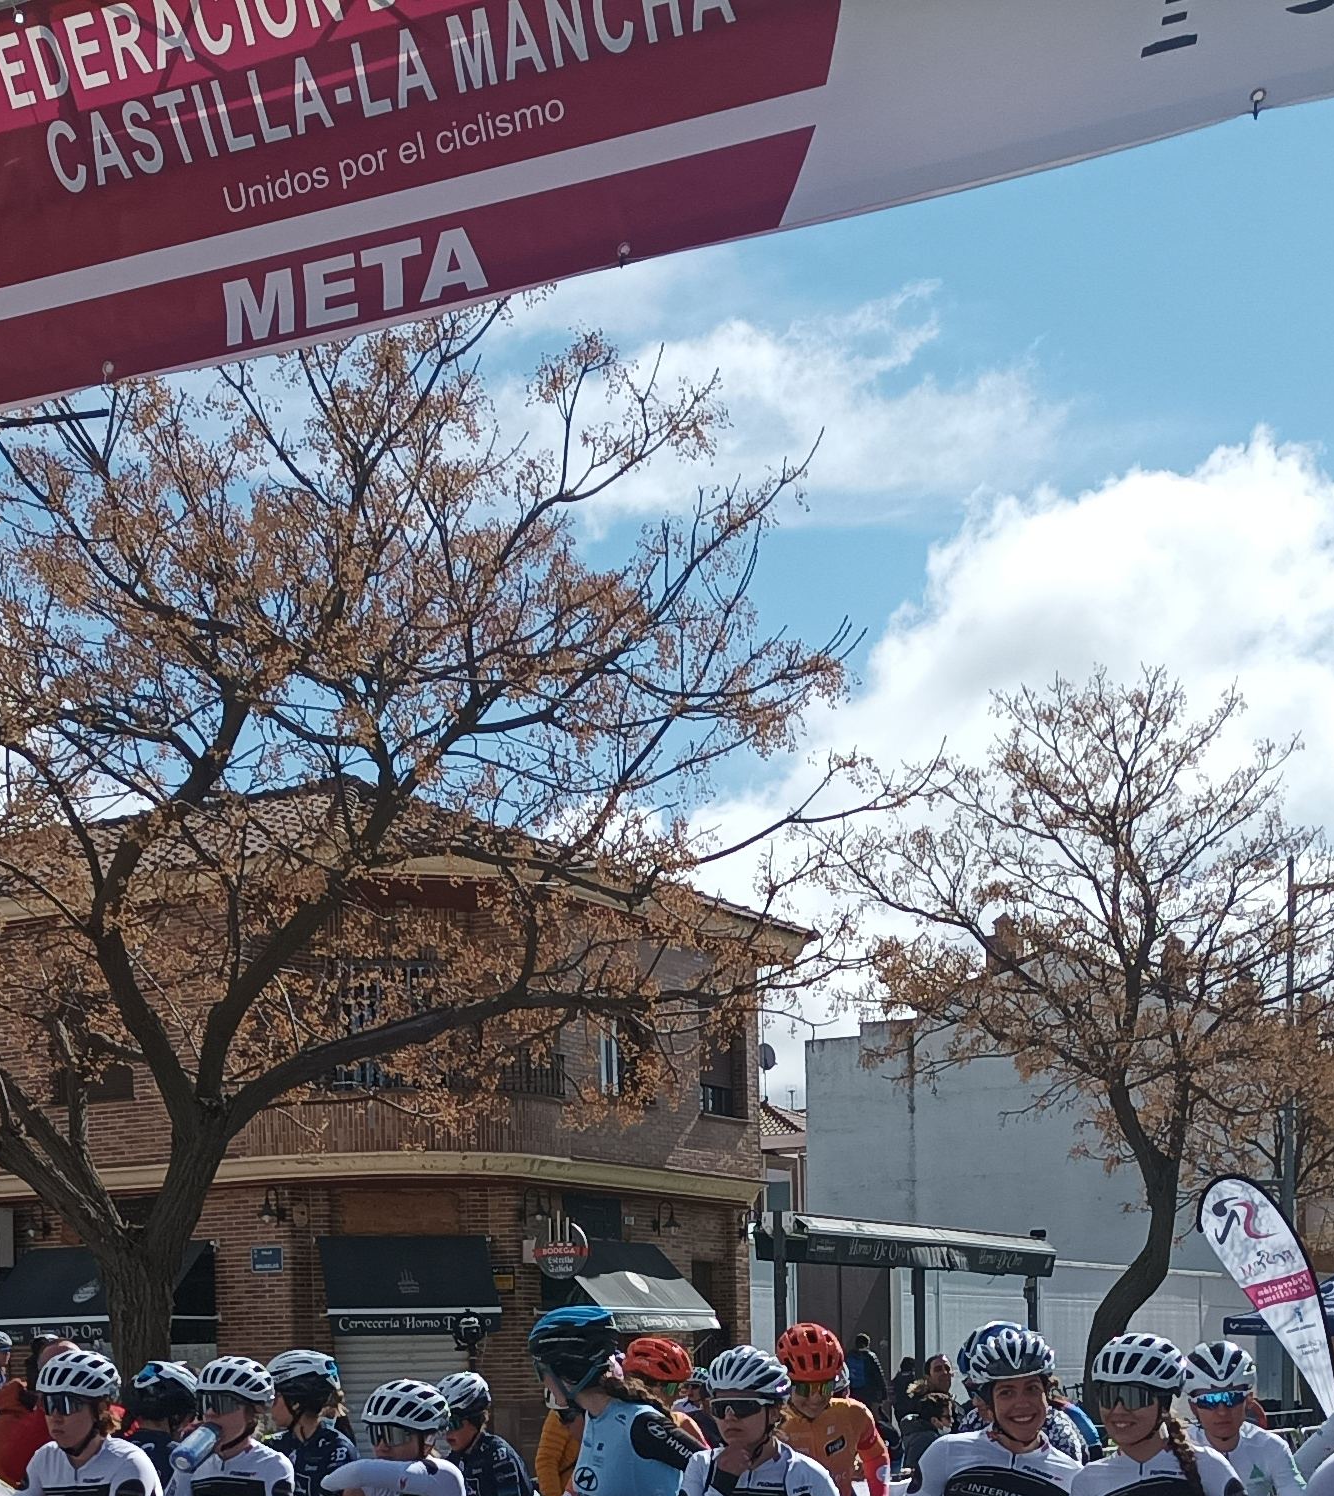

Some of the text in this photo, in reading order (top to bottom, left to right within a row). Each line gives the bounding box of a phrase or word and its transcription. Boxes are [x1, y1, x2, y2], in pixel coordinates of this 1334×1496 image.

[46, 28, 438, 194] CASTILLA-LA
[222, 98, 565, 213] Unidos por el ciclismo
[223, 228, 488, 347] META
[542, 1247, 576, 1255] BODEGA
[402, 1315, 441, 1329] Horno
